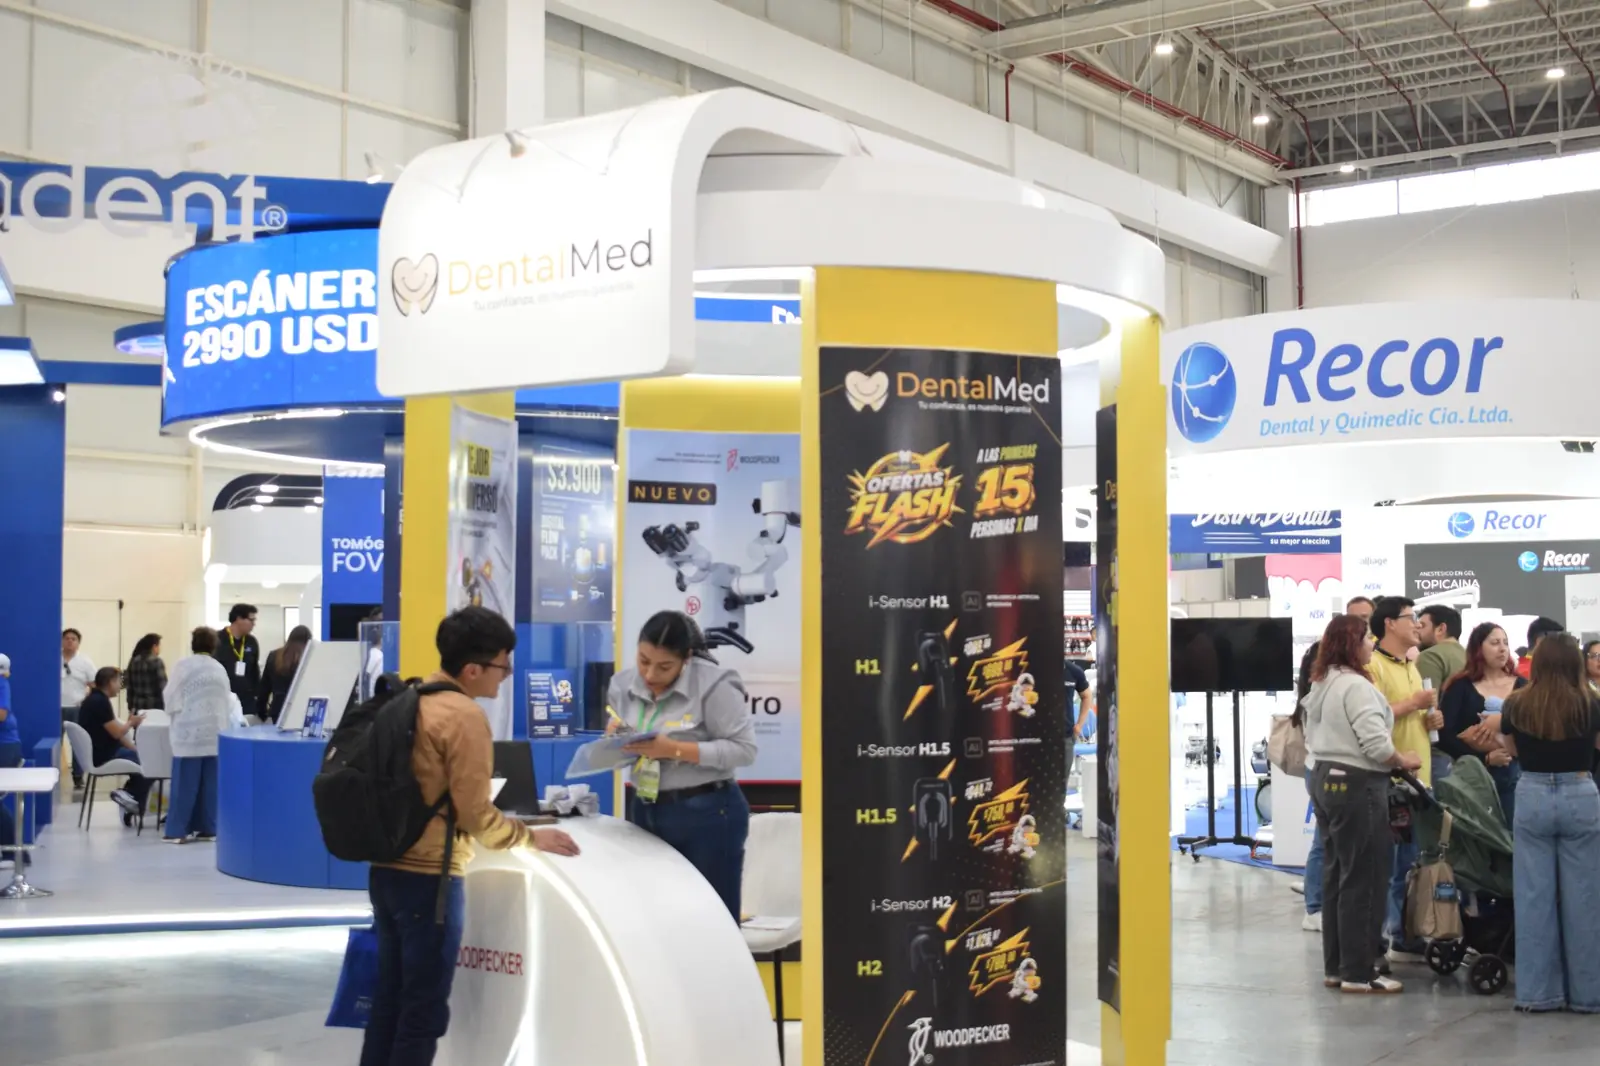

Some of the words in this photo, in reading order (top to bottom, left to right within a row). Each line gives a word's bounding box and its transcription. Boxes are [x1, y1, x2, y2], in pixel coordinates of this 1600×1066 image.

[448, 228, 653, 296] DentalMed
[185, 269, 376, 326] ESCÁNER
[182, 320, 271, 368] 2990
[281, 313, 379, 354] USD
[1263, 327, 1504, 406] Recor
[897, 372, 1049, 403] DentalMed
[1260, 415, 1314, 437] Dental
[1319, 418, 1330, 436] y
[1335, 408, 1423, 434] Quimedic
[1469, 405, 1513, 424] Ltda.
[868, 471, 945, 493] OFERTAS
[975, 464, 1035, 516] 15
[634, 486, 711, 502] NUEVO
[846, 487, 958, 535] FLASH
[1483, 510, 1547, 530] Recor
[332, 535, 384, 550] TOMÓG
[1280, 538, 1301, 546] mejor
[332, 551, 384, 573] FOV
[1543, 550, 1590, 566] Recor
[1414, 578, 1480, 590] TOPICAINA
[868, 596, 928, 609] i-Sensor
[929, 595, 950, 609] H1
[856, 659, 881, 675] H1
[744, 692, 782, 716] ro
[857, 744, 917, 757] i-Sensor
[918, 742, 951, 756] H1.5
[856, 808, 897, 825] H1.5
[871, 900, 929, 912] i-Sensor
[932, 896, 952, 909] H2
[456, 946, 524, 976] OODPECKER
[857, 960, 883, 976] H2
[934, 1023, 1011, 1048] WOODPECKER
